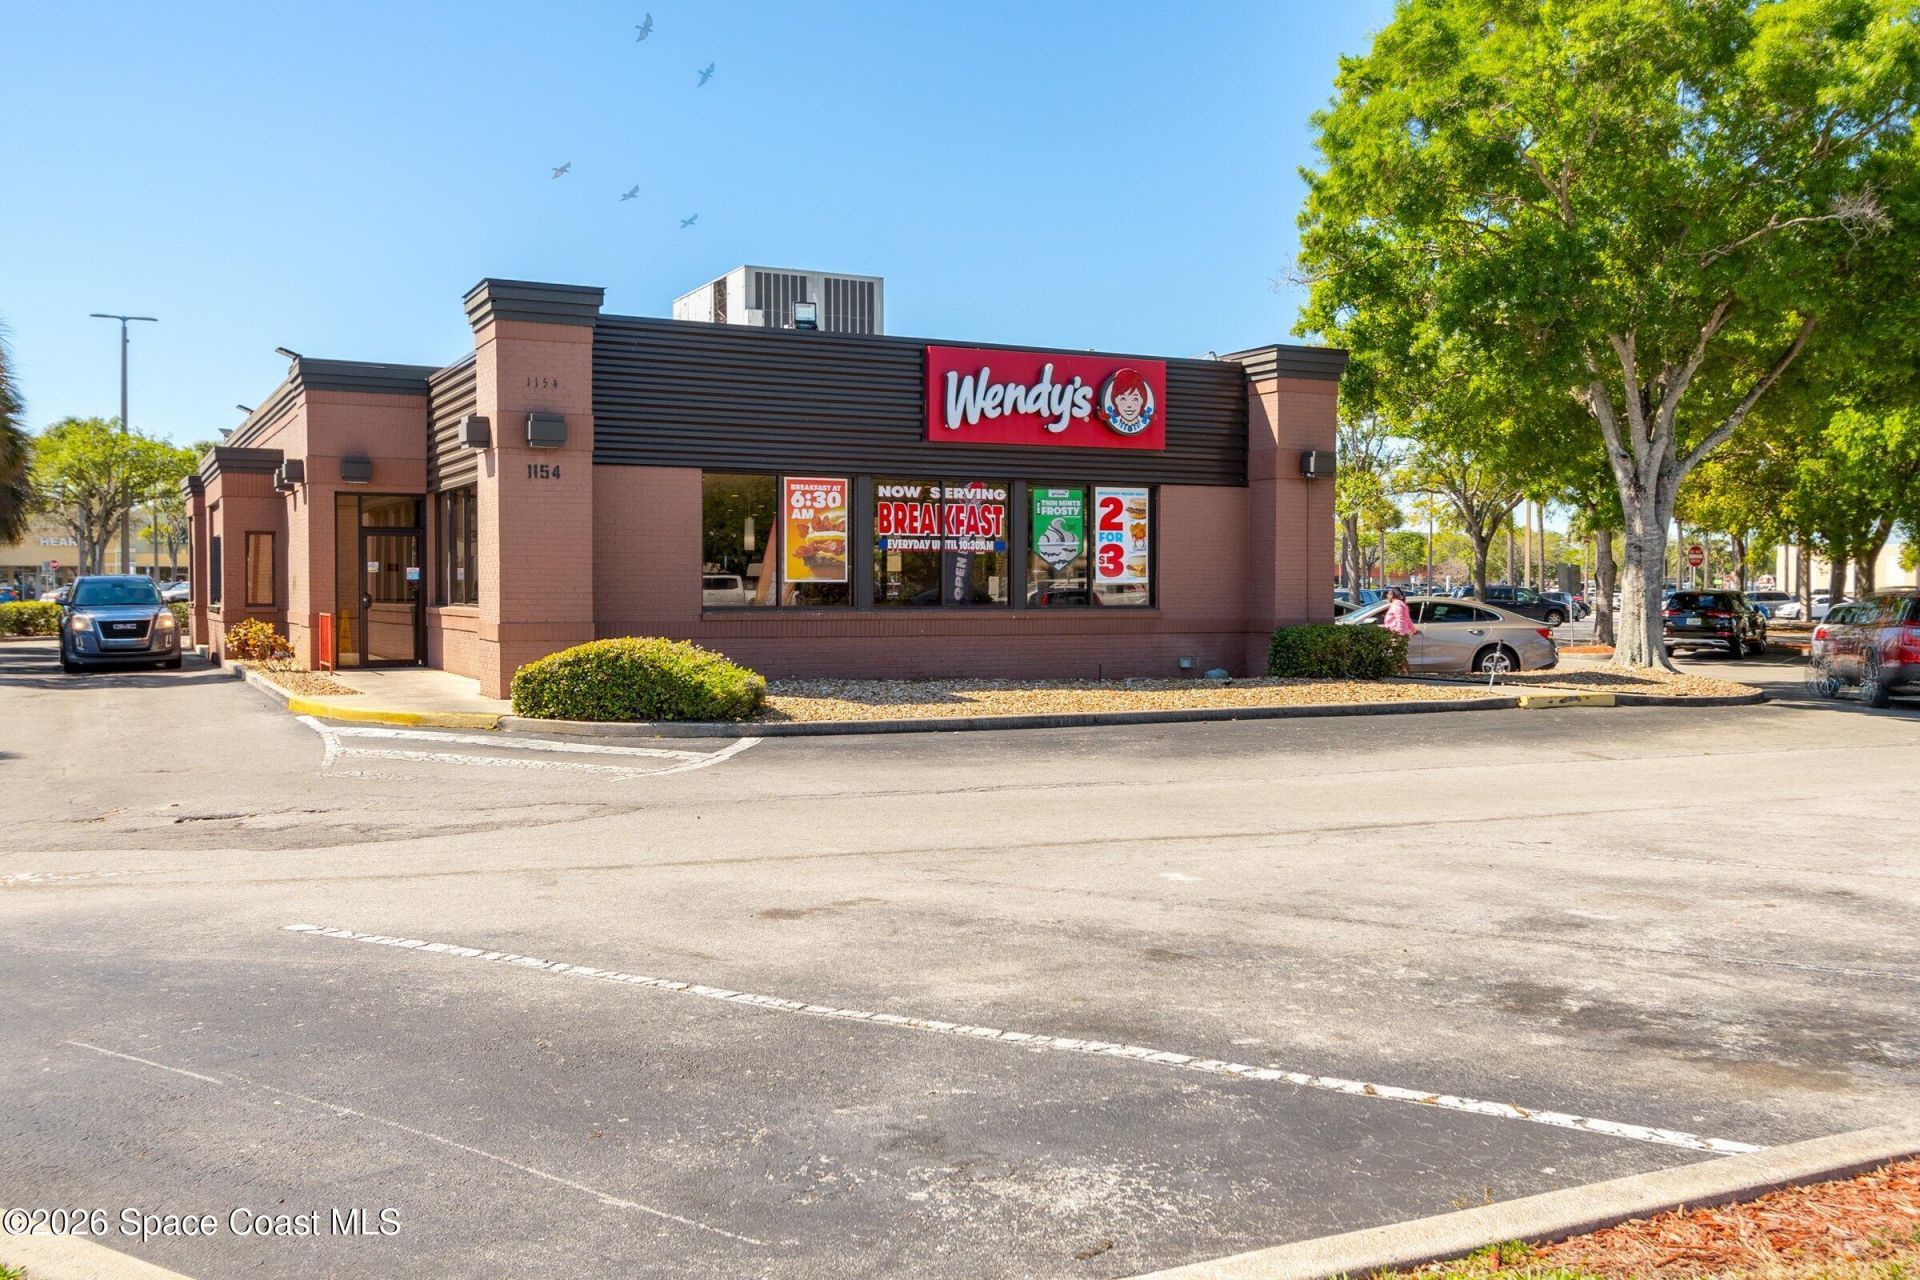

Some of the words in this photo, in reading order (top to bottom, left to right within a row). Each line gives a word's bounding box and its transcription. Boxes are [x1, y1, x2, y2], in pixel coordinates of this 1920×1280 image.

[527, 377, 558, 388] 1154
[946, 363, 1093, 433] Wendy's
[527, 464, 560, 479] 1154
[790, 483, 831, 491] BREAKFAST
[878, 485, 921, 498] NOW
[930, 487, 1007, 500] SERVING
[790, 491, 842, 508] 6:30
[791, 508, 814, 519] AM
[1041, 506, 1080, 516] FROSTY
[1099, 496, 1124, 532] 2
[877, 501, 1004, 537] BREAKFAST
[1099, 532, 1124, 543] FOR
[887, 539, 930, 550] EVERYDAY
[959, 540, 994, 551] 10:30AM
